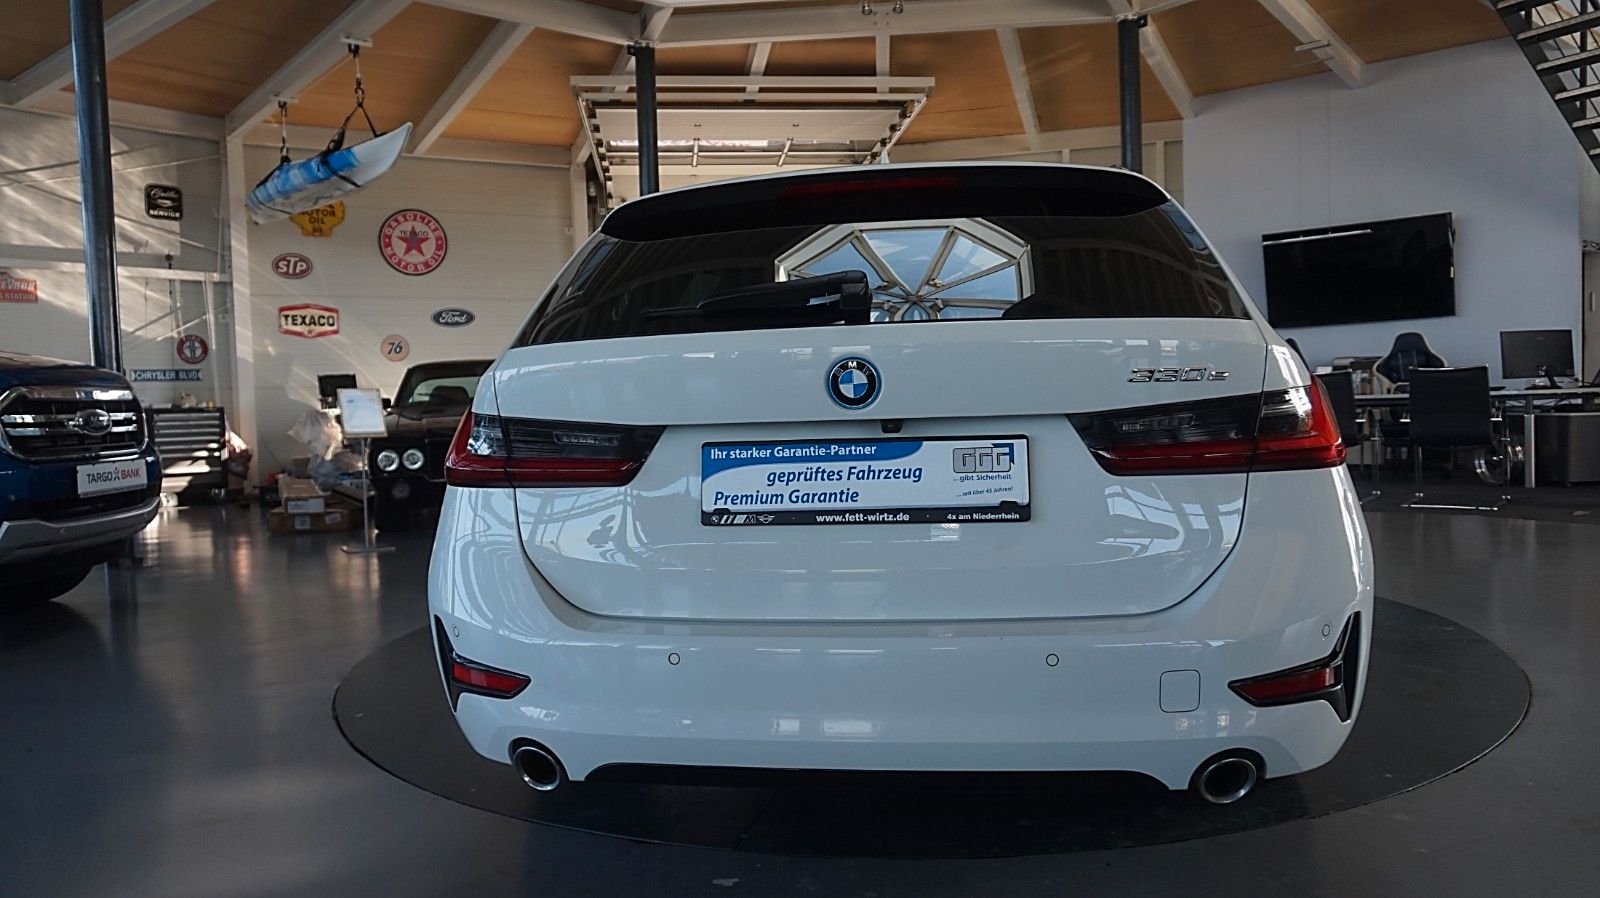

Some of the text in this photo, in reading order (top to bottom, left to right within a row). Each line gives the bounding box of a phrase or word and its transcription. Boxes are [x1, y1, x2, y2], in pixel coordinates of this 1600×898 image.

[308, 216, 326, 224] OIL
[278, 256, 308, 274] STP
[386, 247, 443, 271] MOTOR OIL
[282, 314, 336, 327] TEXACO
[439, 311, 467, 323] Ford
[386, 341, 403, 355] 76
[135, 370, 198, 380] CHRYSLER BLVD
[710, 444, 877, 459] Ihr starker Garantie-Partner
[86, 468, 141, 484] TARGO BANK
[767, 465, 923, 487] geprüftes Fahrzeug
[714, 488, 859, 506] Premium Garantie
[816, 512, 910, 523] www.fett-wirtz.de
[972, 512, 1020, 520] Niederrhein
